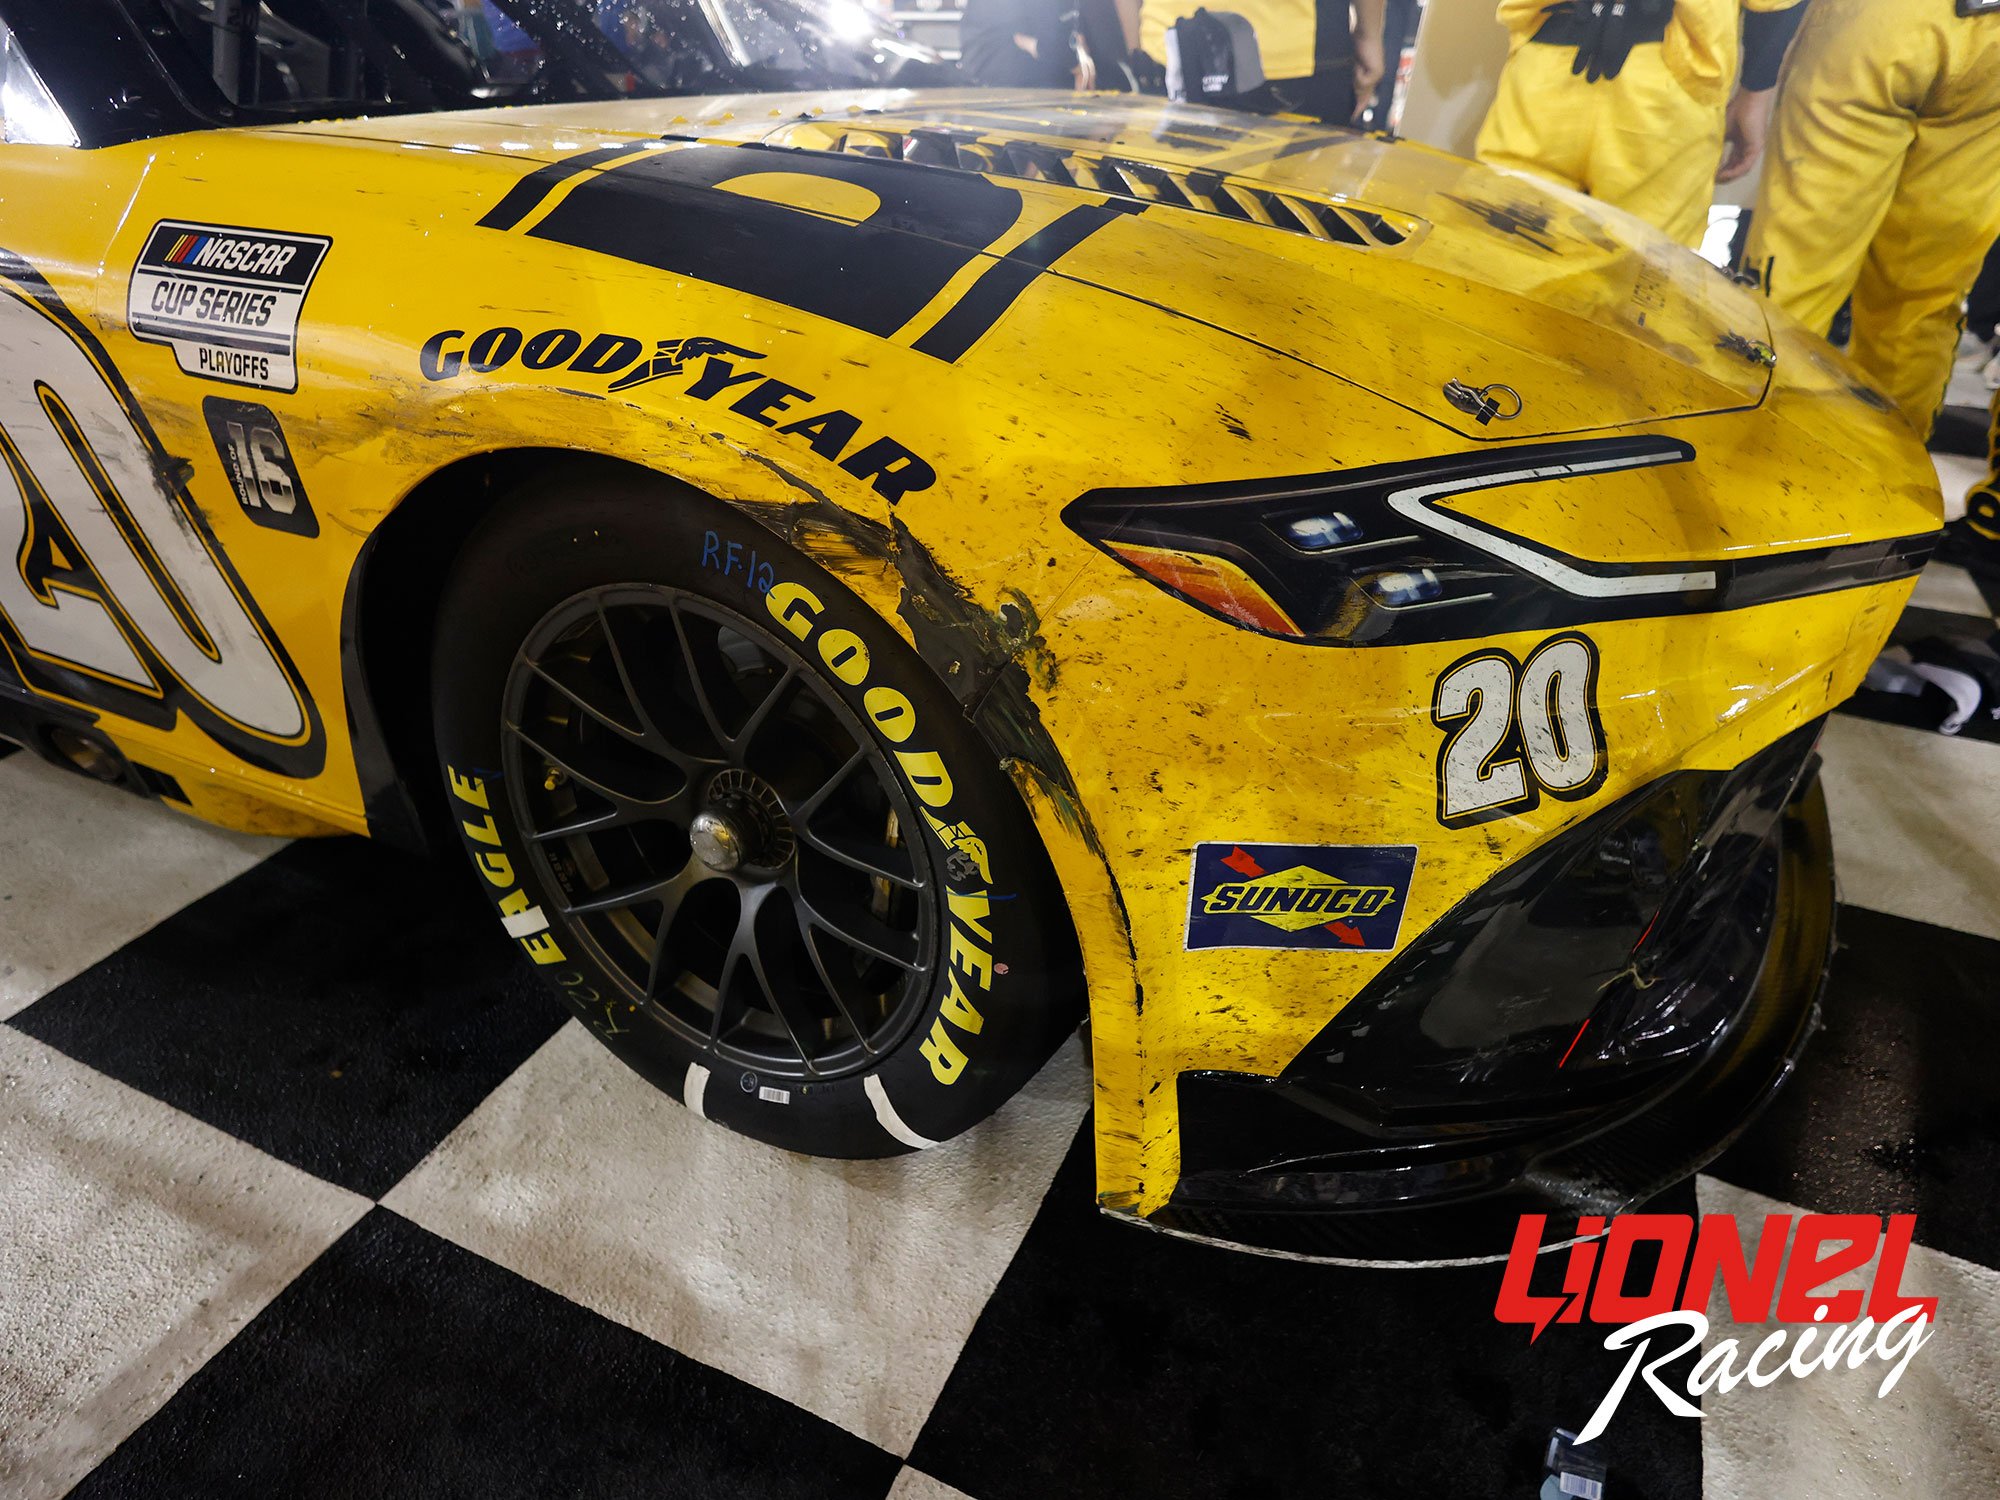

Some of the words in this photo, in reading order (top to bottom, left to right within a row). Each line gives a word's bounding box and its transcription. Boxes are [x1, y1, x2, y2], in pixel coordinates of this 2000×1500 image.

[192, 236, 297, 276] NASCAR
[151, 280, 198, 315] CUP
[196, 286, 277, 327] SERIES
[199, 347, 269, 381] PLAYOFFS
[419, 326, 937, 506] GOODYEAR
[226, 420, 297, 515] 16
[227, 443, 237, 460] OF
[232, 462, 249, 505] ROUND
[1435, 632, 1606, 827] 20
[765, 581, 994, 1086] GOODYEAR
[1214, 884, 1388, 915] SUNOCO
